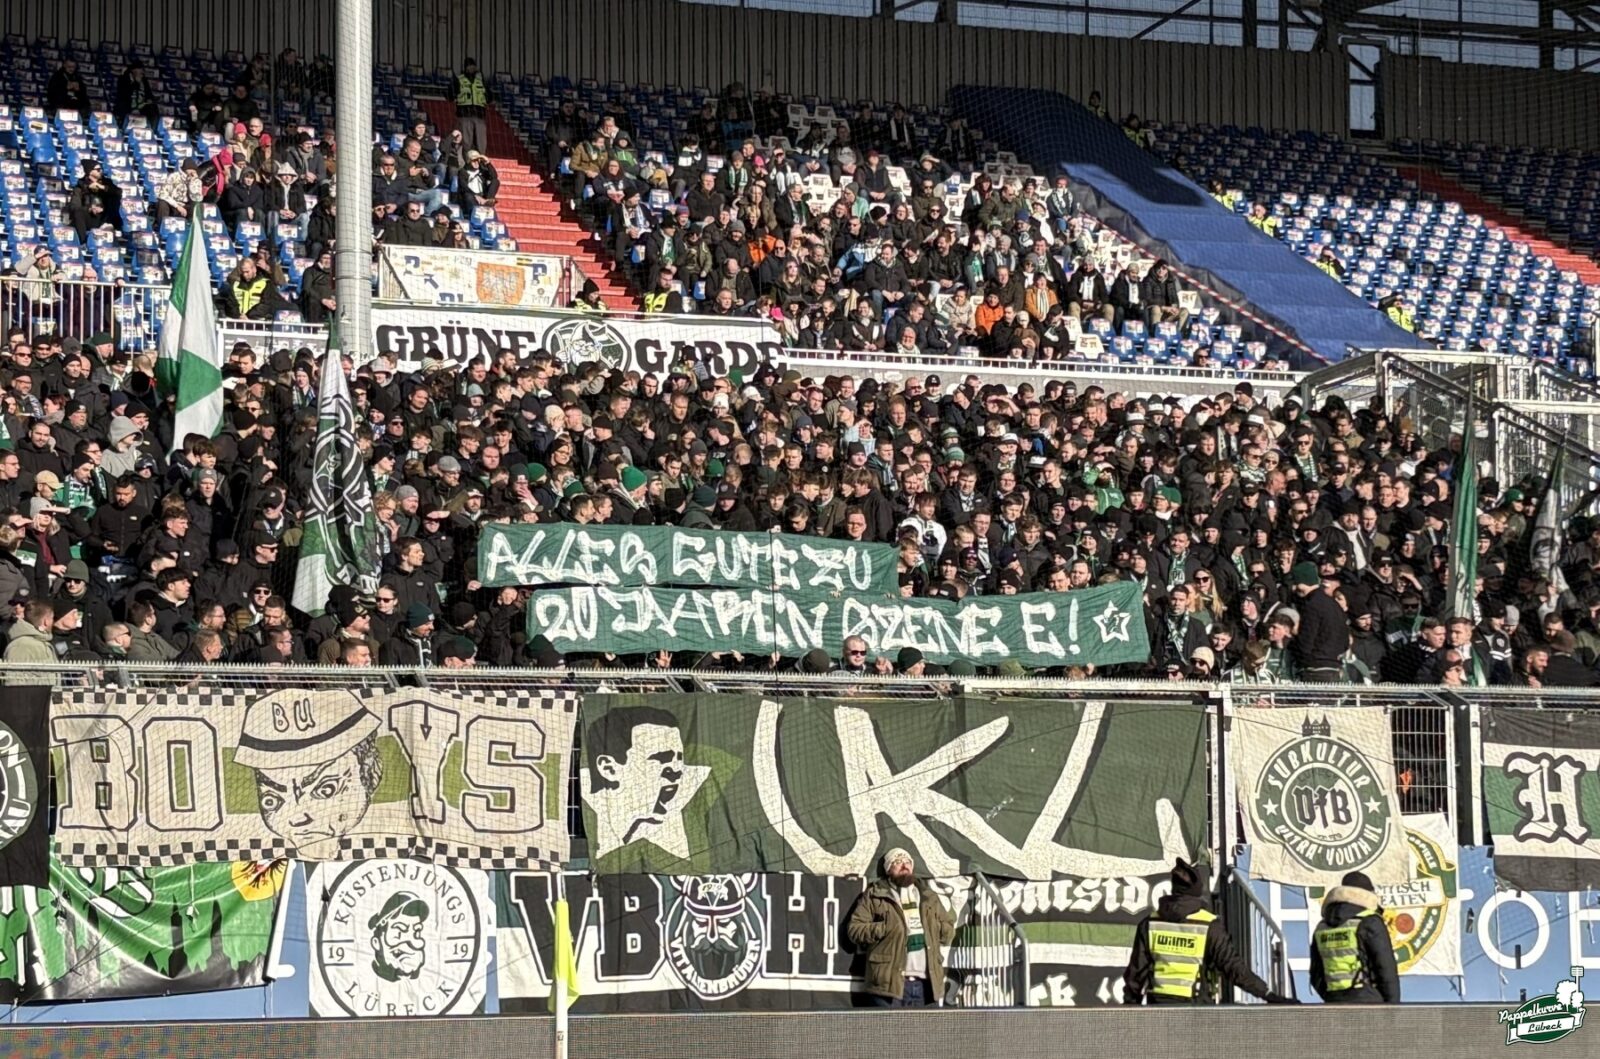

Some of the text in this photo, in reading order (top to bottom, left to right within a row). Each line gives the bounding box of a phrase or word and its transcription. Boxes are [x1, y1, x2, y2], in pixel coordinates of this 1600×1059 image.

[376, 321, 536, 366] GRÜNE
[635, 338, 788, 377] GARDE
[486, 529, 871, 591] ALLES GUTE ZU
[535, 585, 598, 642] 20
[597, 585, 829, 649] JAHREN
[1021, 597, 1081, 658] E!
[272, 697, 313, 731] BU
[51, 699, 546, 833] BOYS
[1267, 740, 1371, 791] SUBKULTUR
[1325, 837, 1372, 866] YOUTH
[334, 863, 465, 925] KÜSTENJUNGS
[328, 943, 468, 962] 19 19
[344, 980, 454, 1017] LÜBECK
